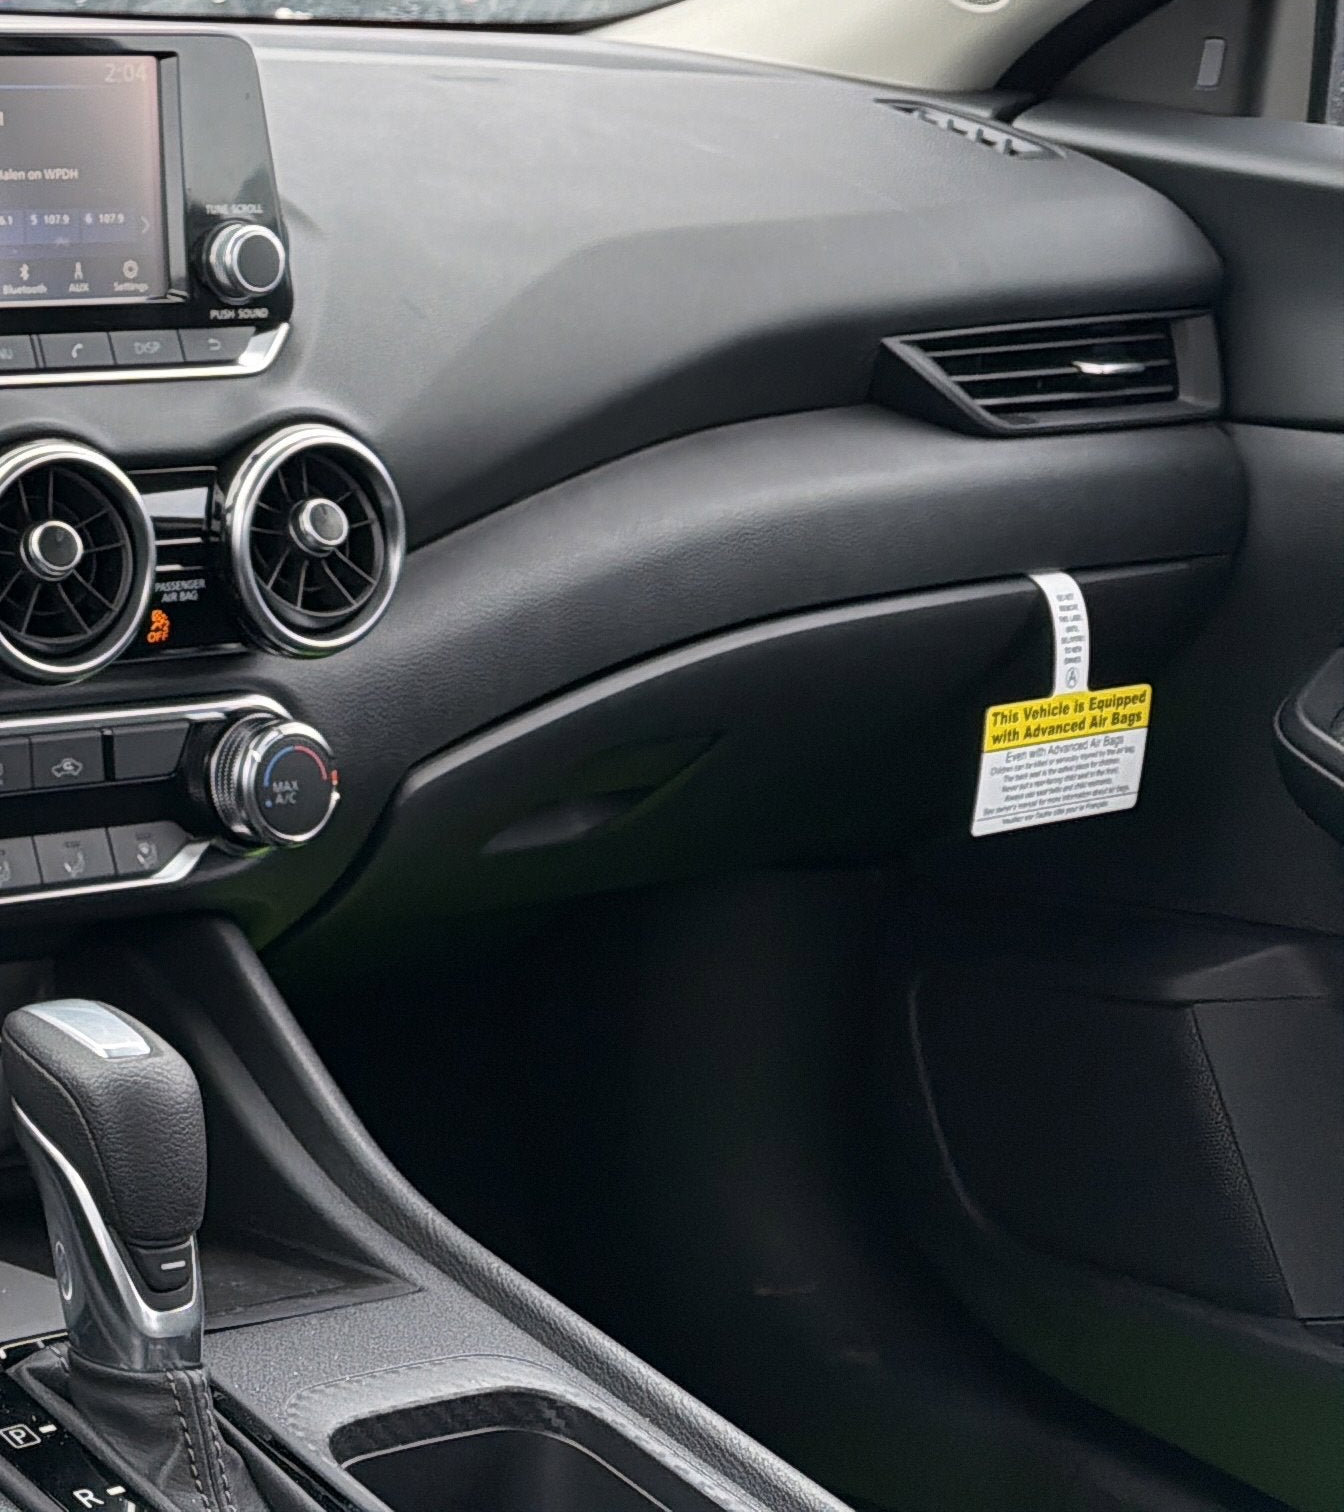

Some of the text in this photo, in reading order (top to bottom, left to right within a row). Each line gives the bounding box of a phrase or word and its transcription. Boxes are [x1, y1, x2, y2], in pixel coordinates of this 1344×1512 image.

[104, 64, 147, 83] 2:04
[27, 171, 42, 180] on
[43, 168, 79, 180] WPDH
[134, 341, 161, 355] DISP
[154, 578, 206, 593] PASSENGER
[161, 590, 199, 603] AIR BAG
[146, 628, 169, 643] OFF
[991, 688, 1148, 727] This Vehicle is Equipped
[992, 710, 1143, 745] with Advanced Air Bags
[1048, 741, 1089, 755] Advanced
[273, 780, 299, 793] MAX
[275, 792, 297, 804] A/C
[73, 1489, 105, 1509] R
